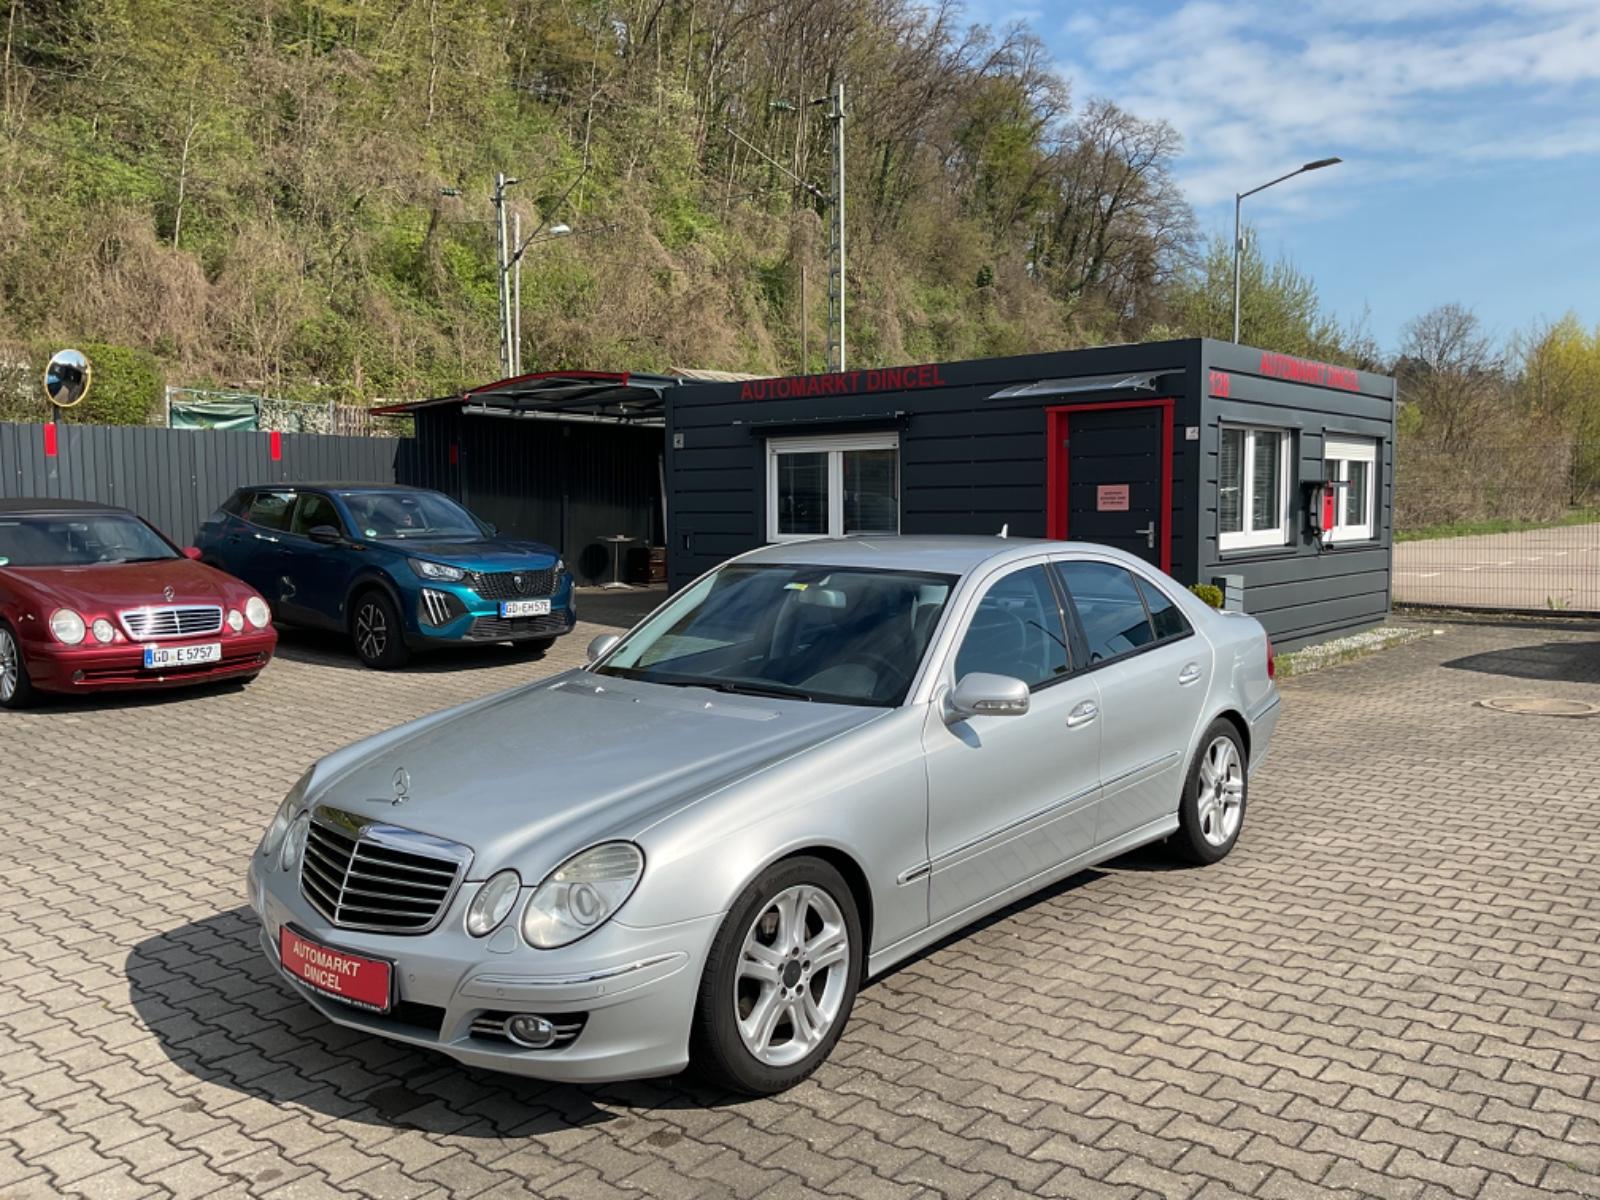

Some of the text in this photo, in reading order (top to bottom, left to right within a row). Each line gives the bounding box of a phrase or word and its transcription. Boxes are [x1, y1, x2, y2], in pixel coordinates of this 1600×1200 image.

[740, 364, 945, 400] AUTOMARKT DINCEL
[154, 646, 213, 663] GD E 5757
[293, 941, 361, 977] AUTOMARKT
[304, 963, 342, 991] DINCEL
